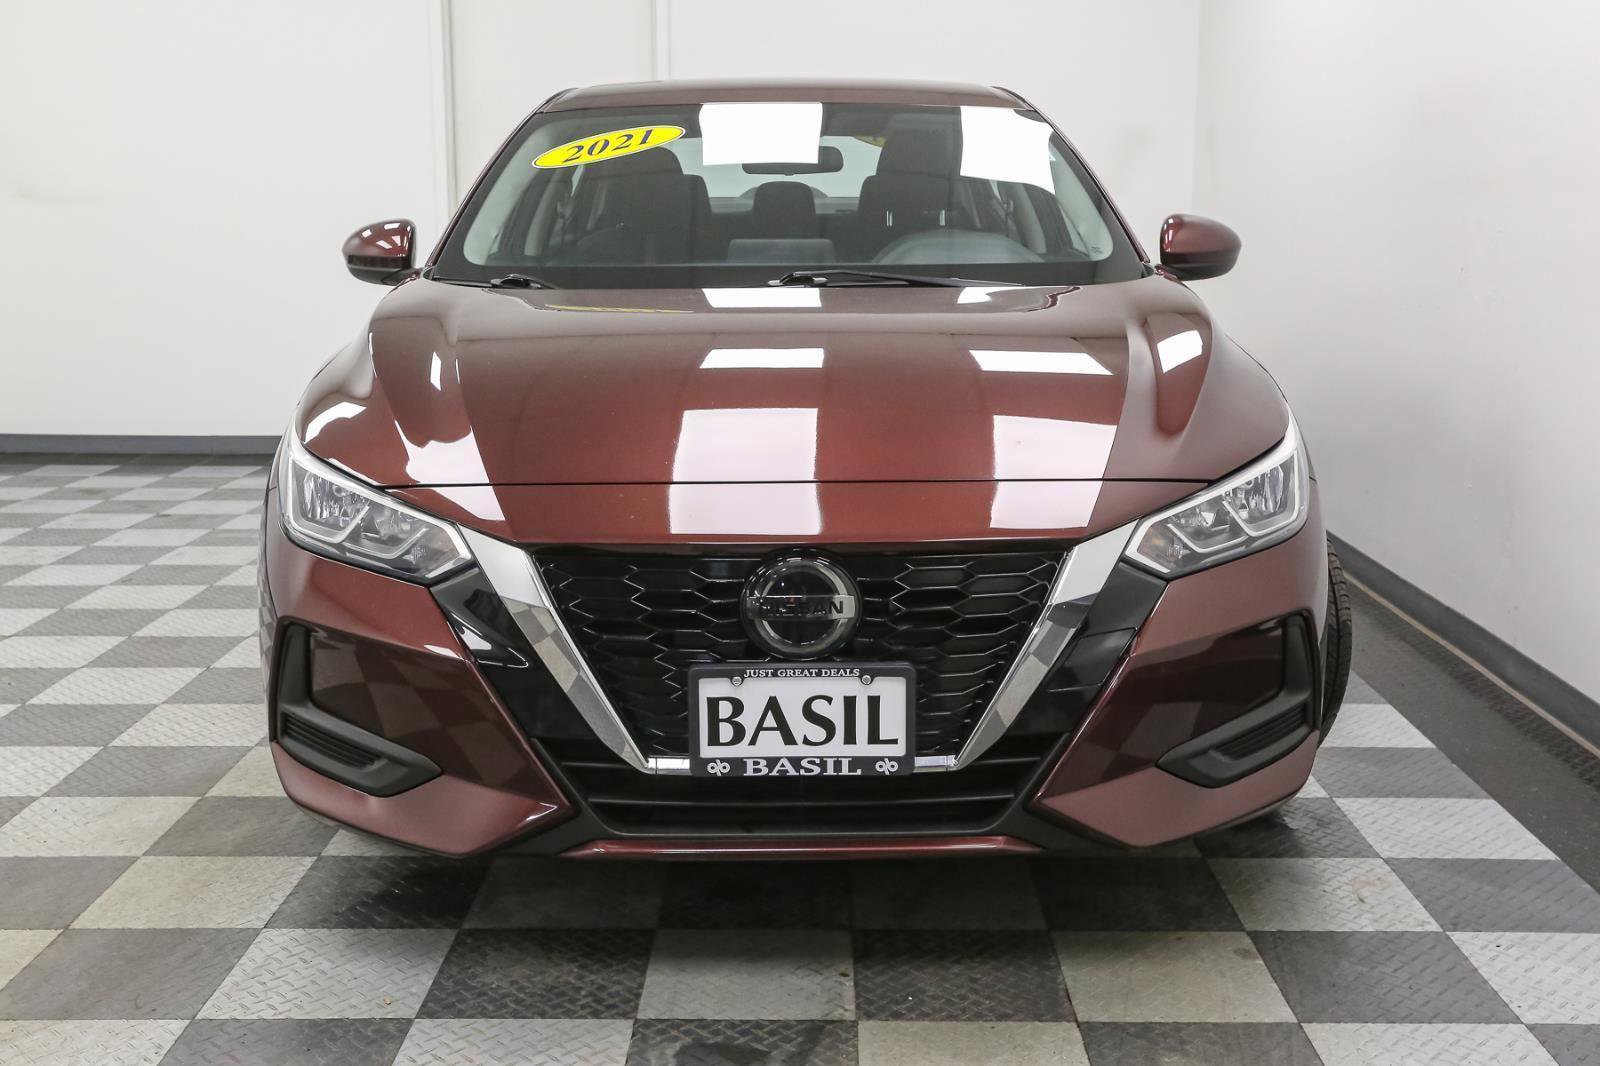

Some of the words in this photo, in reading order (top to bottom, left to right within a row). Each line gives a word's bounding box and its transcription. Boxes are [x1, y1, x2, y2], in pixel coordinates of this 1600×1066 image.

[562, 129, 653, 163] 2021
[743, 668, 774, 678] JUST
[777, 668, 818, 677] GREAT
[821, 668, 860, 677] DEALS
[706, 695, 899, 747] BASIL
[743, 757, 862, 776] BASIL
